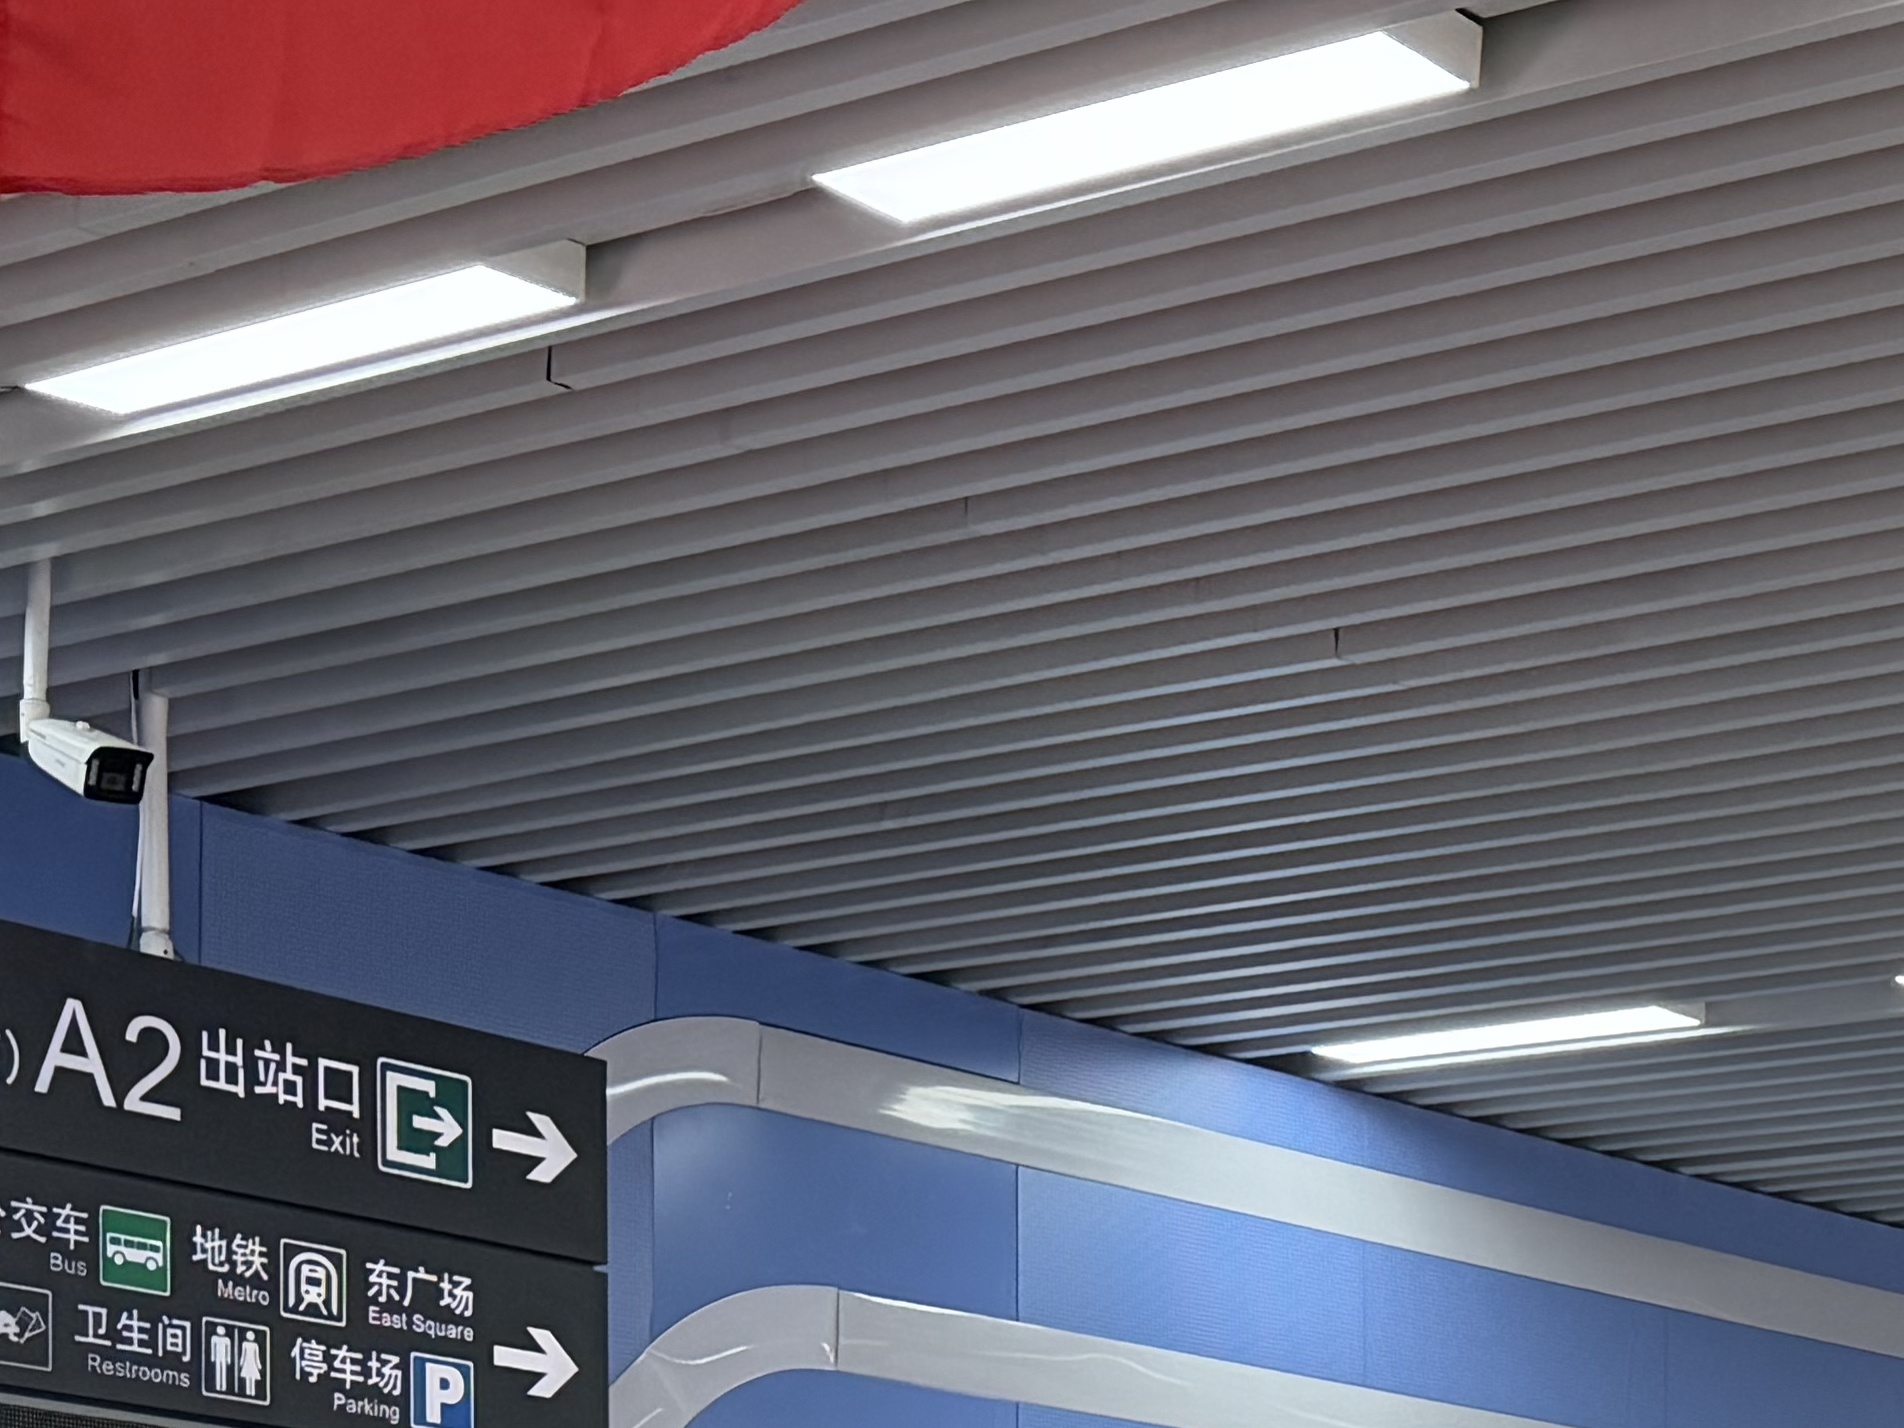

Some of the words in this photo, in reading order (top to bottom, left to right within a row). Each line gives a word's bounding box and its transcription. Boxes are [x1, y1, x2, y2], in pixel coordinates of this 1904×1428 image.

[34, 997, 182, 1122] A2
[200, 1028, 360, 1119] 出站口
[311, 1122, 360, 1158] Exit
[0, 1197, 90, 1250] 交车
[49, 1252, 88, 1277] Bus
[192, 1224, 269, 1281] 地铁
[217, 1279, 270, 1306] Metro
[365, 1259, 474, 1318] 东广场
[74, 1303, 192, 1362] 卫生间
[368, 1306, 408, 1331] East
[412, 1316, 474, 1342] Square
[87, 1353, 191, 1388] Restrooms
[291, 1337, 402, 1396] 停车场
[333, 1392, 400, 1425] Parking
[425, 1362, 465, 1425] P
